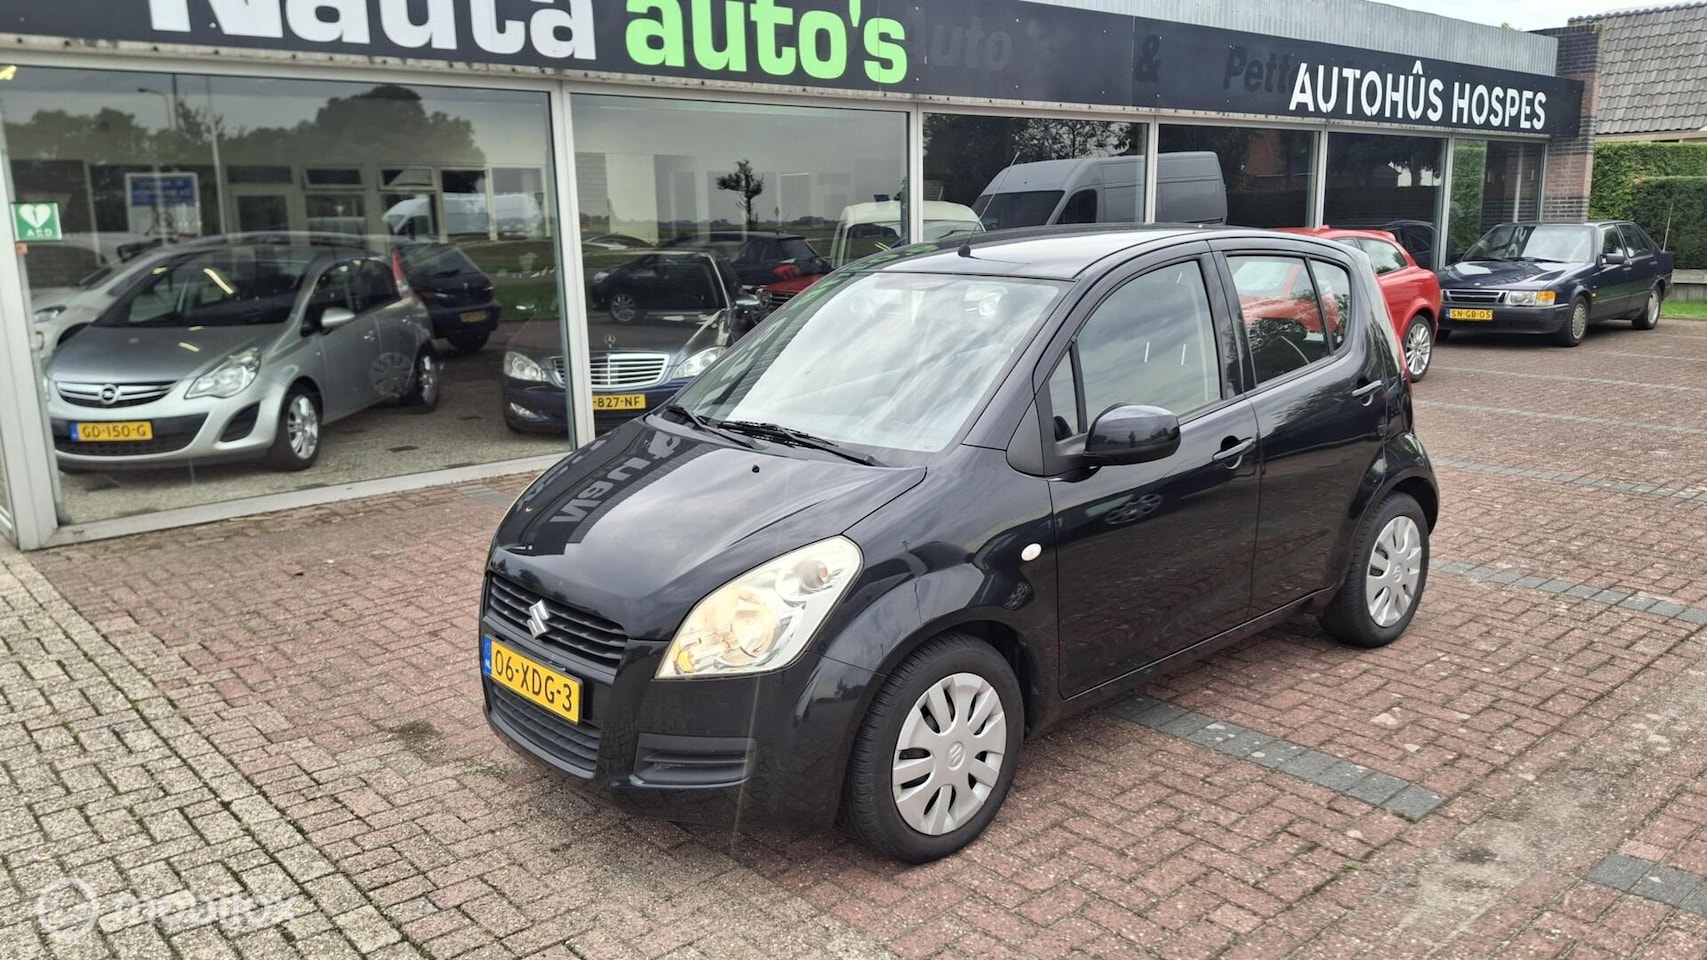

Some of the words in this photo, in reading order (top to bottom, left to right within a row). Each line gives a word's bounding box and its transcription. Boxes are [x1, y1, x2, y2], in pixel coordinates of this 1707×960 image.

[625, 0, 908, 84] auto's
[1289, 60, 1444, 122] AUTOHÛS
[1452, 82, 1547, 130] HOSPES
[1451, 310, 1491, 319] SN-GB-05
[82, 424, 146, 438] GD-150-G
[495, 649, 572, 712] 06-XDG-3
